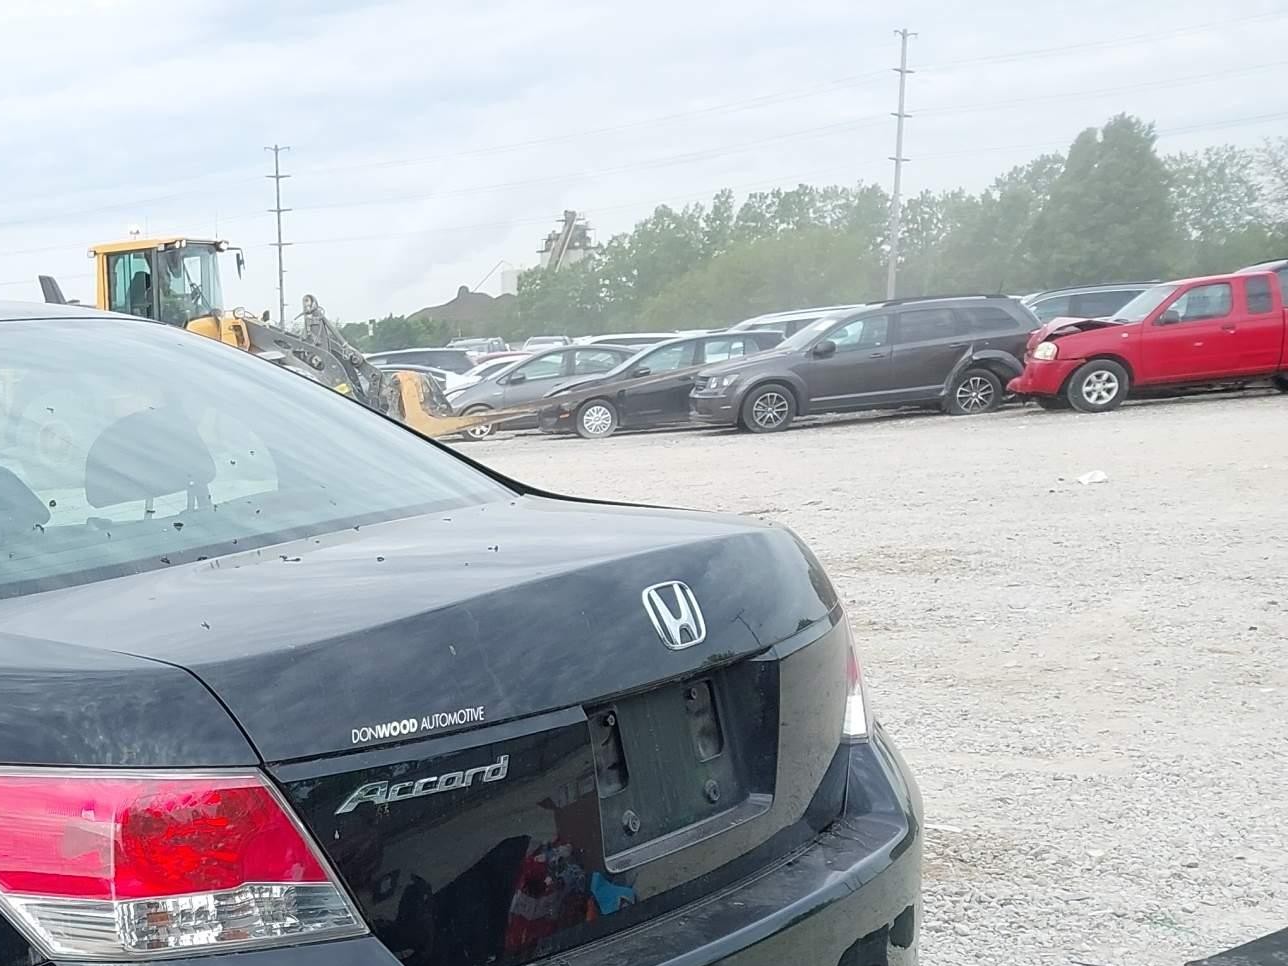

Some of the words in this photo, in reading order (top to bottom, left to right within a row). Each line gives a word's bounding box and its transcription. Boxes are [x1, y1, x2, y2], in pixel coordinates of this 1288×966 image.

[351, 718, 418, 744] DONWOOD
[420, 706, 485, 732] AUTOMOTIVE
[334, 754, 510, 815] Accord
